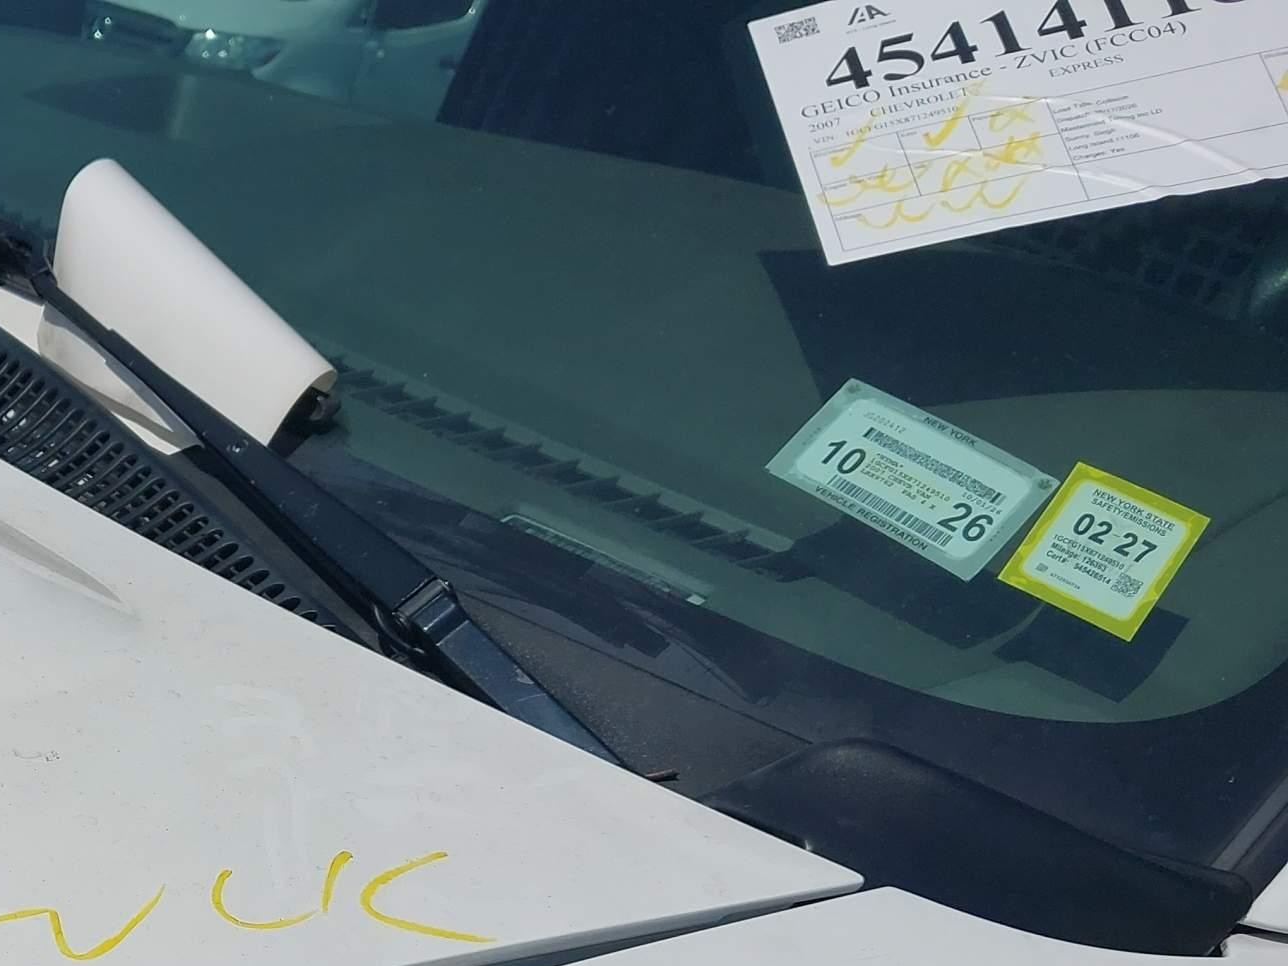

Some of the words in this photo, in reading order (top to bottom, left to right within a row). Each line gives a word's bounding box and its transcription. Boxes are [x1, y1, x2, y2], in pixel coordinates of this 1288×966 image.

[800, 89, 882, 119] GEICO
[888, 65, 993, 98] Insurance
[1014, 43, 1078, 70] ZVIC
[1084, 20, 1188, 56] (FCC04)
[825, 0, 1249, 91] 454141
[808, 117, 841, 133] 2007
[870, 87, 969, 118] CHEVROLET
[1049, 54, 1125, 78] EXPRESS
[923, 416, 948, 433] NEW
[949, 427, 979, 448] YORK
[820, 439, 867, 475] 10
[815, 485, 859, 515] VEHICLE
[857, 507, 929, 552] REGISTRATION
[937, 502, 994, 543] 26
[1090, 498, 1167, 538] SAFETY/EMISSIONS
[1092, 488, 1117, 504] NEW
[1116, 499, 1145, 516] YORK
[1145, 512, 1176, 532] STATE
[1073, 512, 1113, 546] 02
[1113, 532, 1158, 564] 27
